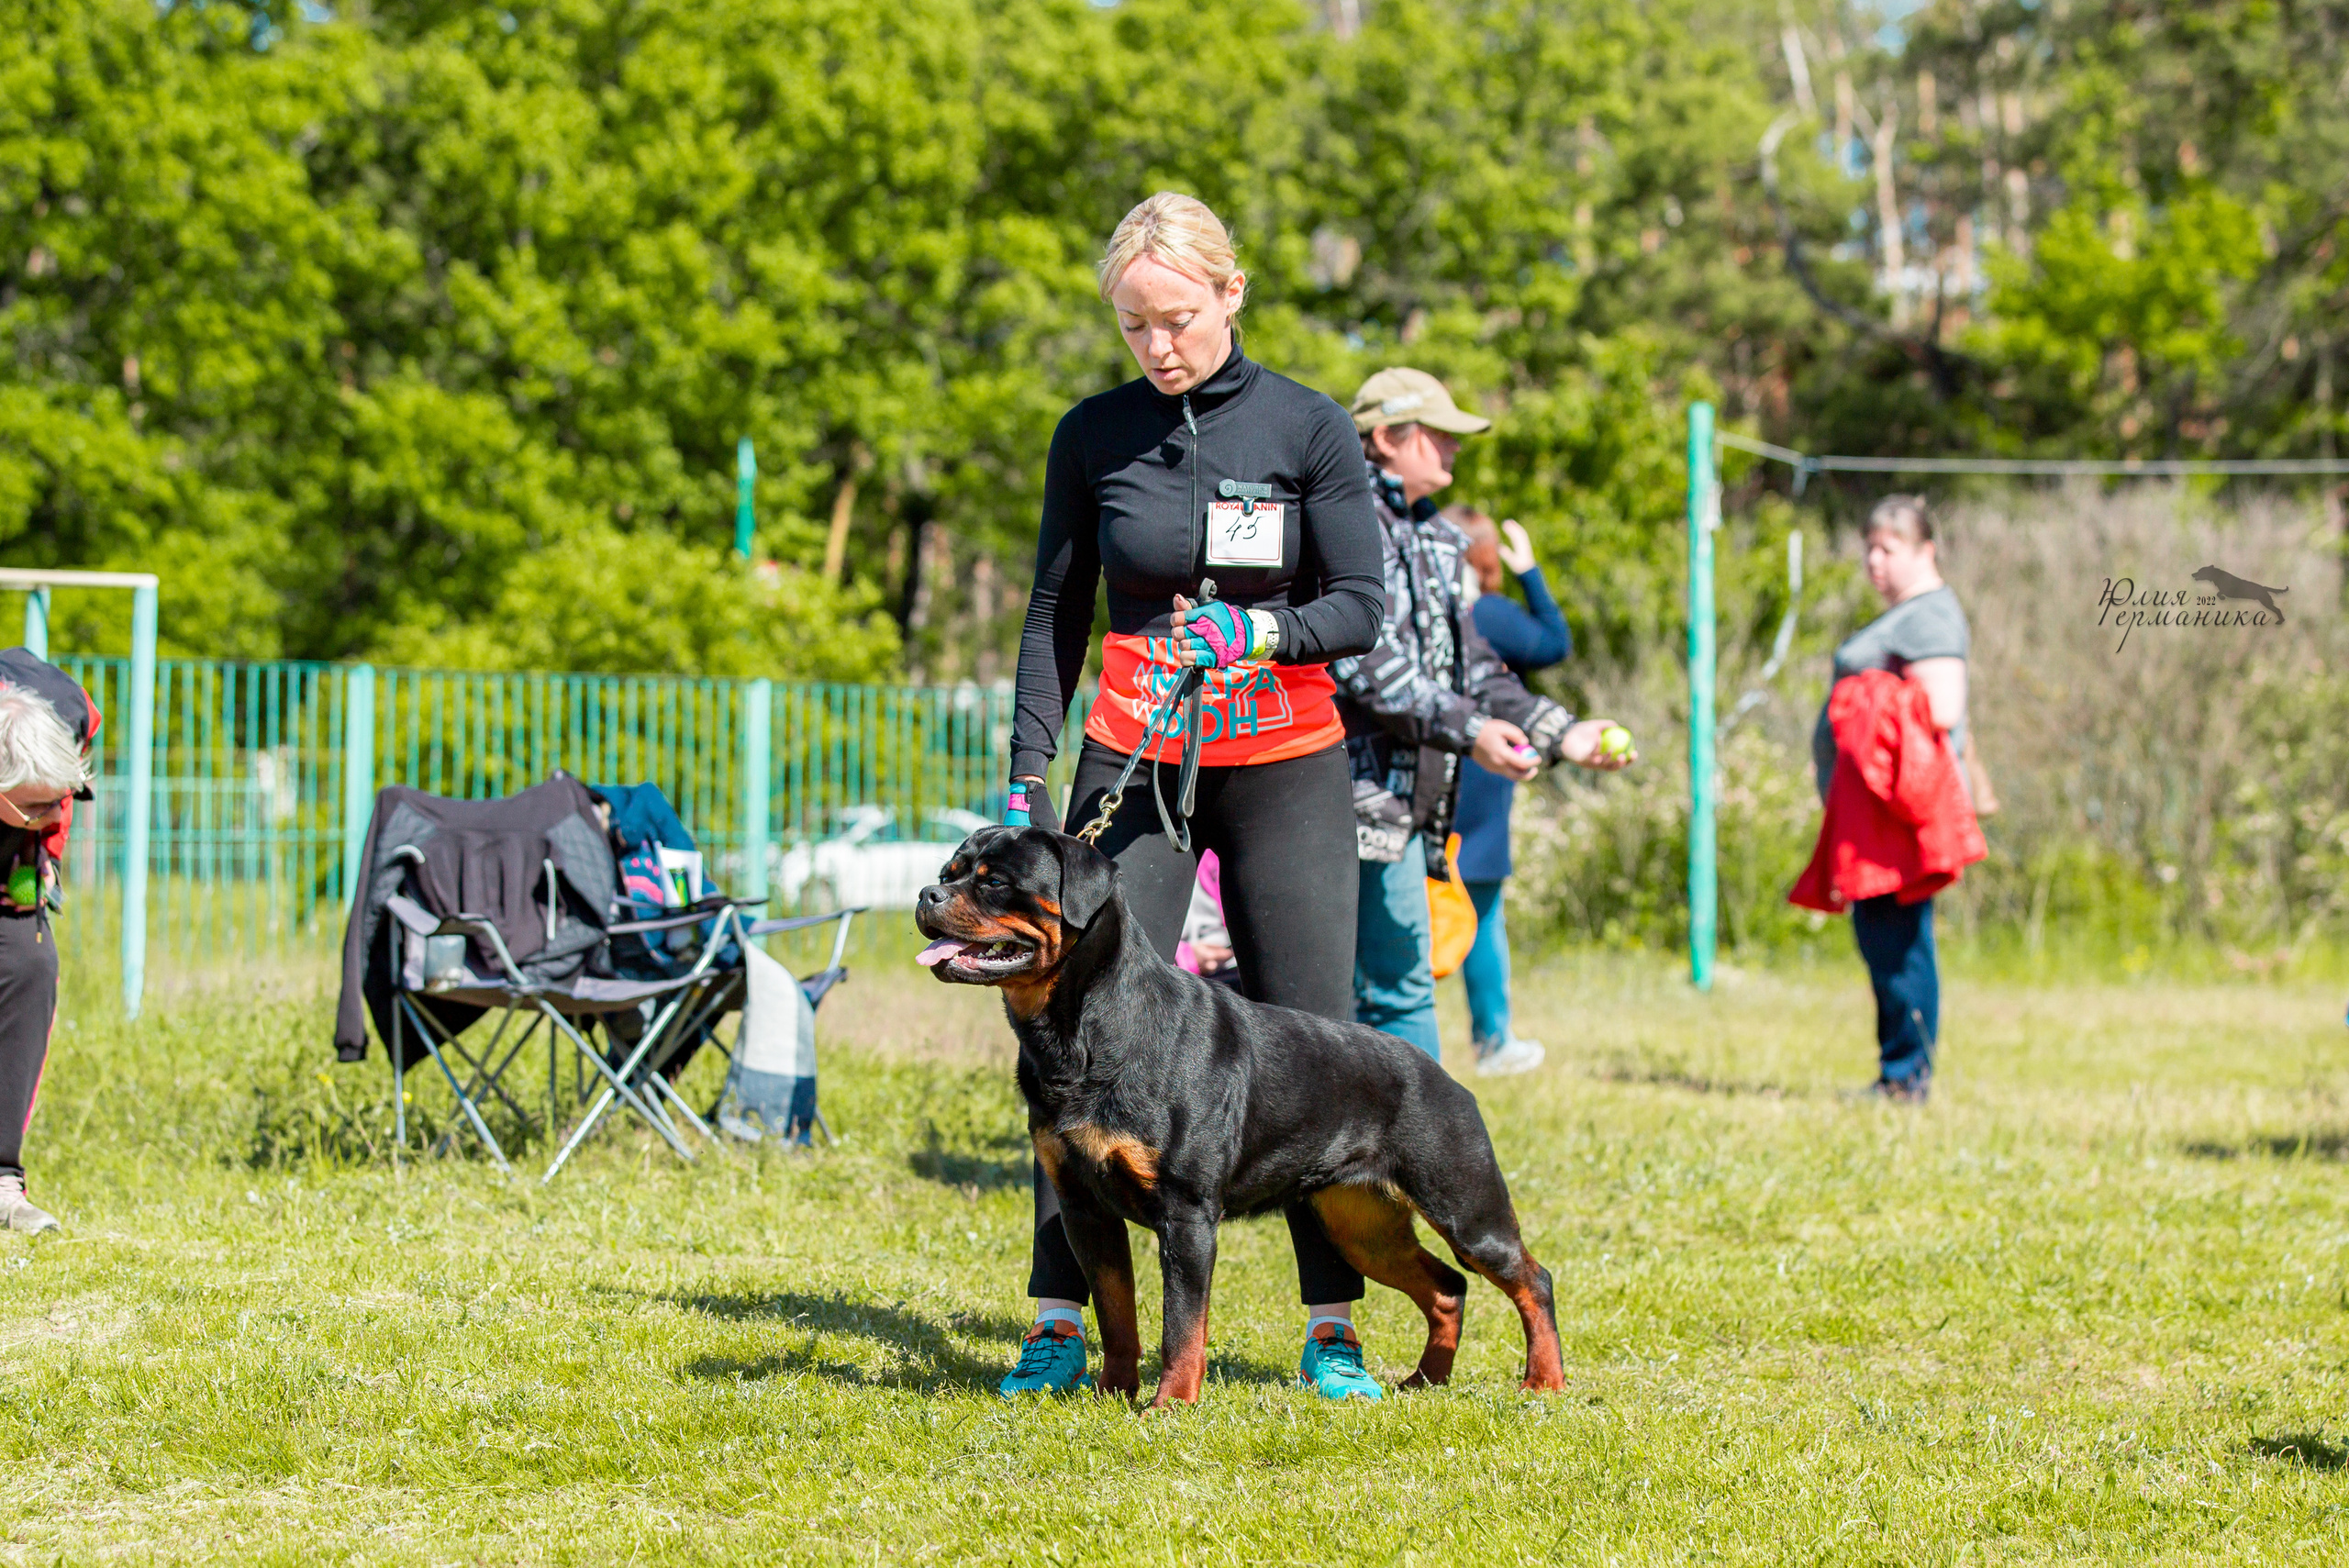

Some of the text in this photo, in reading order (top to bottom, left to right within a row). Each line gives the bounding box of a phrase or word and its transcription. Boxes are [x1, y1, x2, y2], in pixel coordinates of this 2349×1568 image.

[1215, 501, 1277, 511] ROYAL ANIN
[1226, 516, 1266, 541] 45
